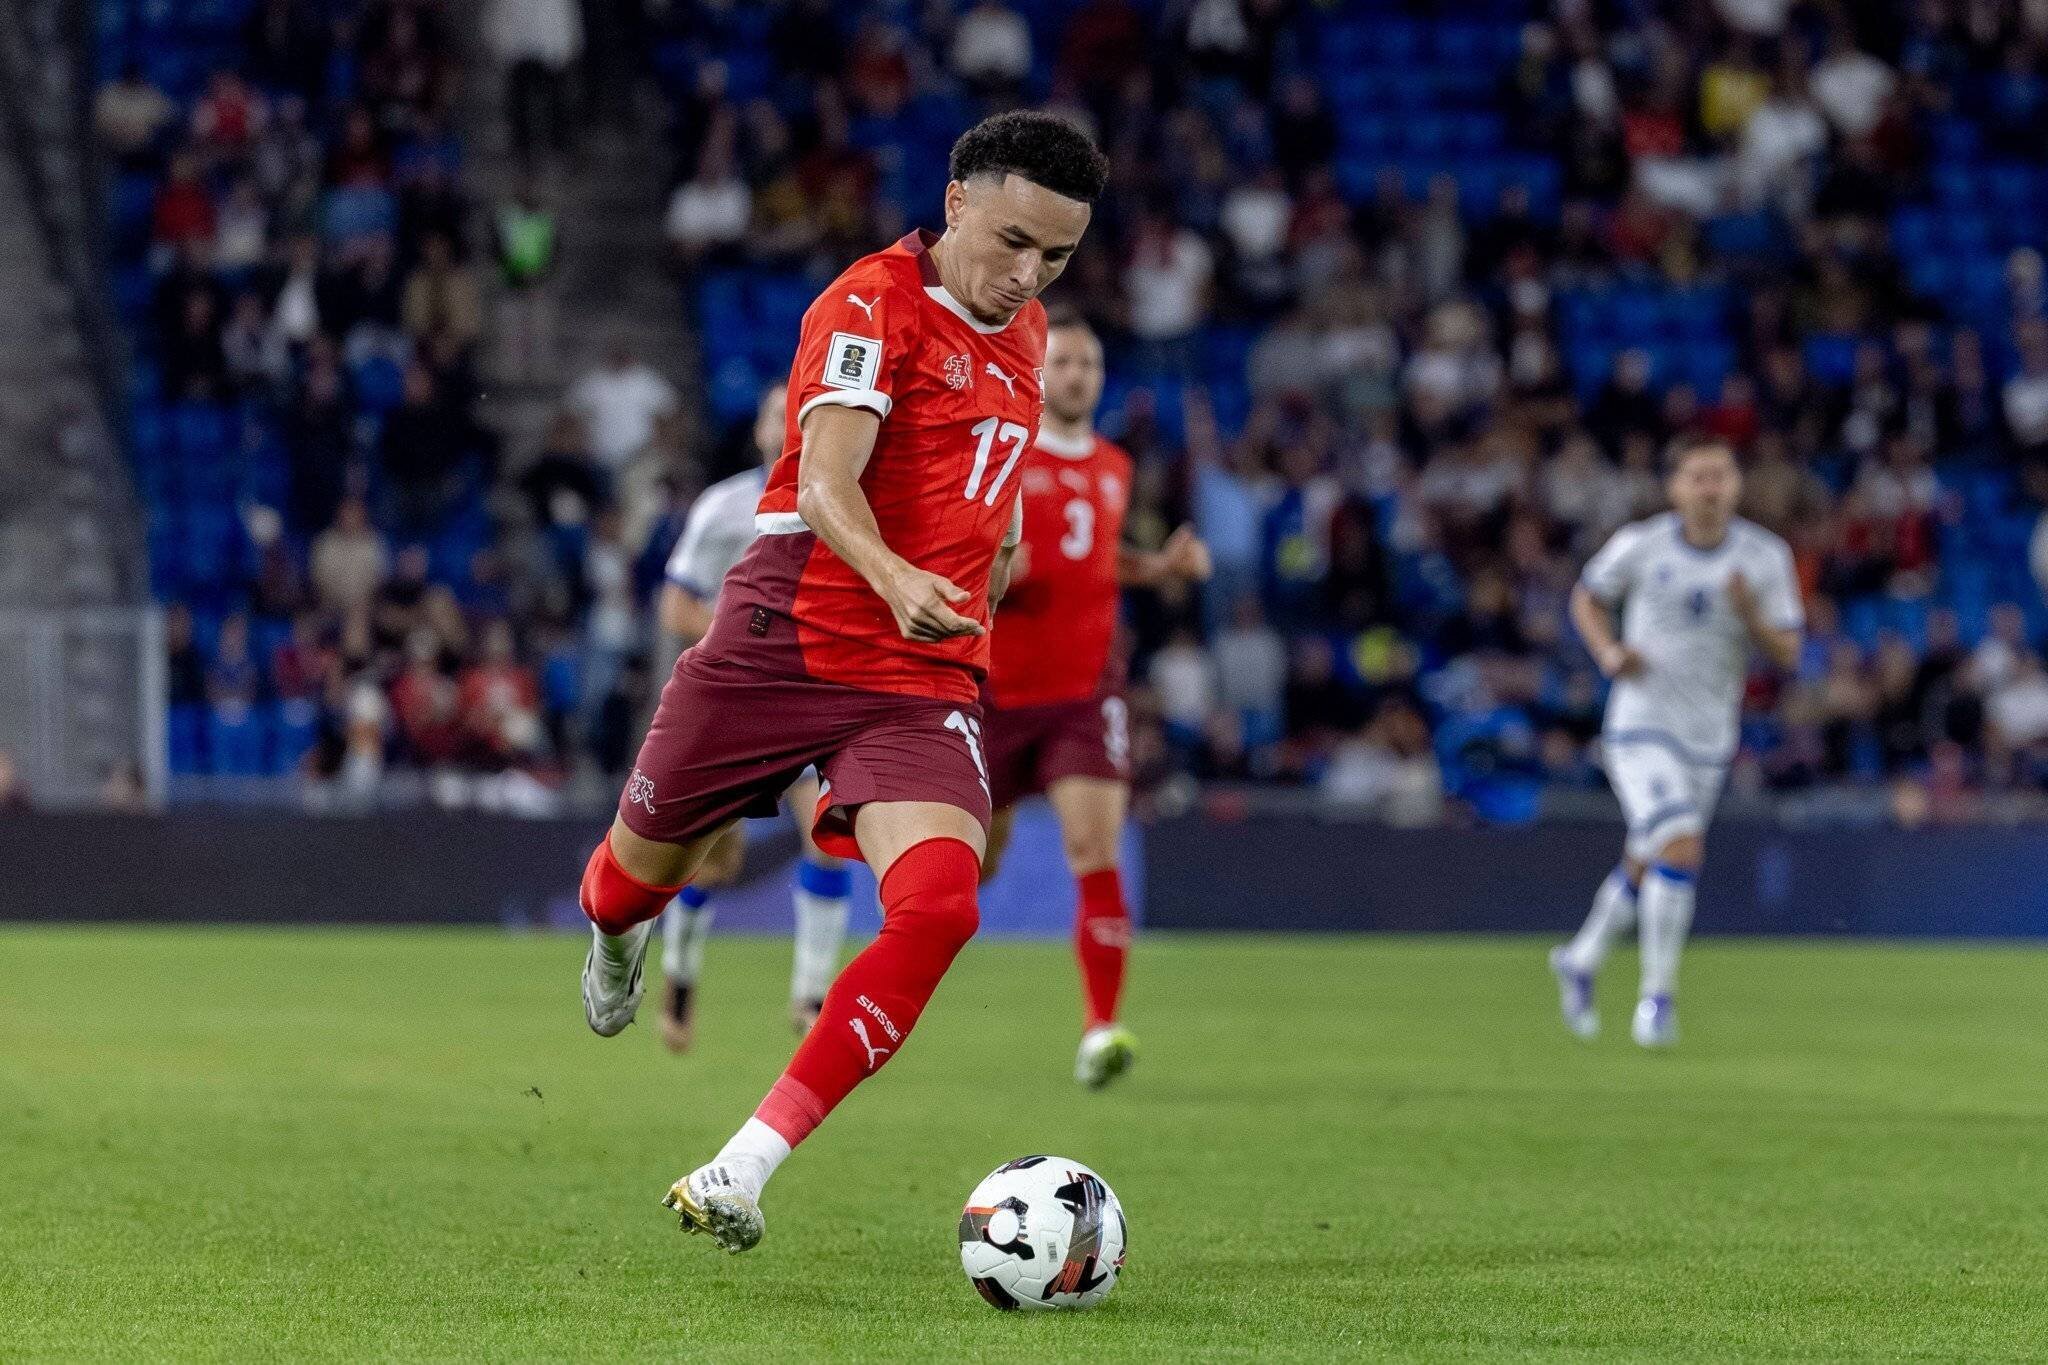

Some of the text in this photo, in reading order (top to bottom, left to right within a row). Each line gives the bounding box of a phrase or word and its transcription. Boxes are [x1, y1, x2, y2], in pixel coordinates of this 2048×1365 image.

[964, 416, 1029, 507] 17
[1061, 499, 1095, 560] 3
[856, 995, 901, 1043] SUISSE
